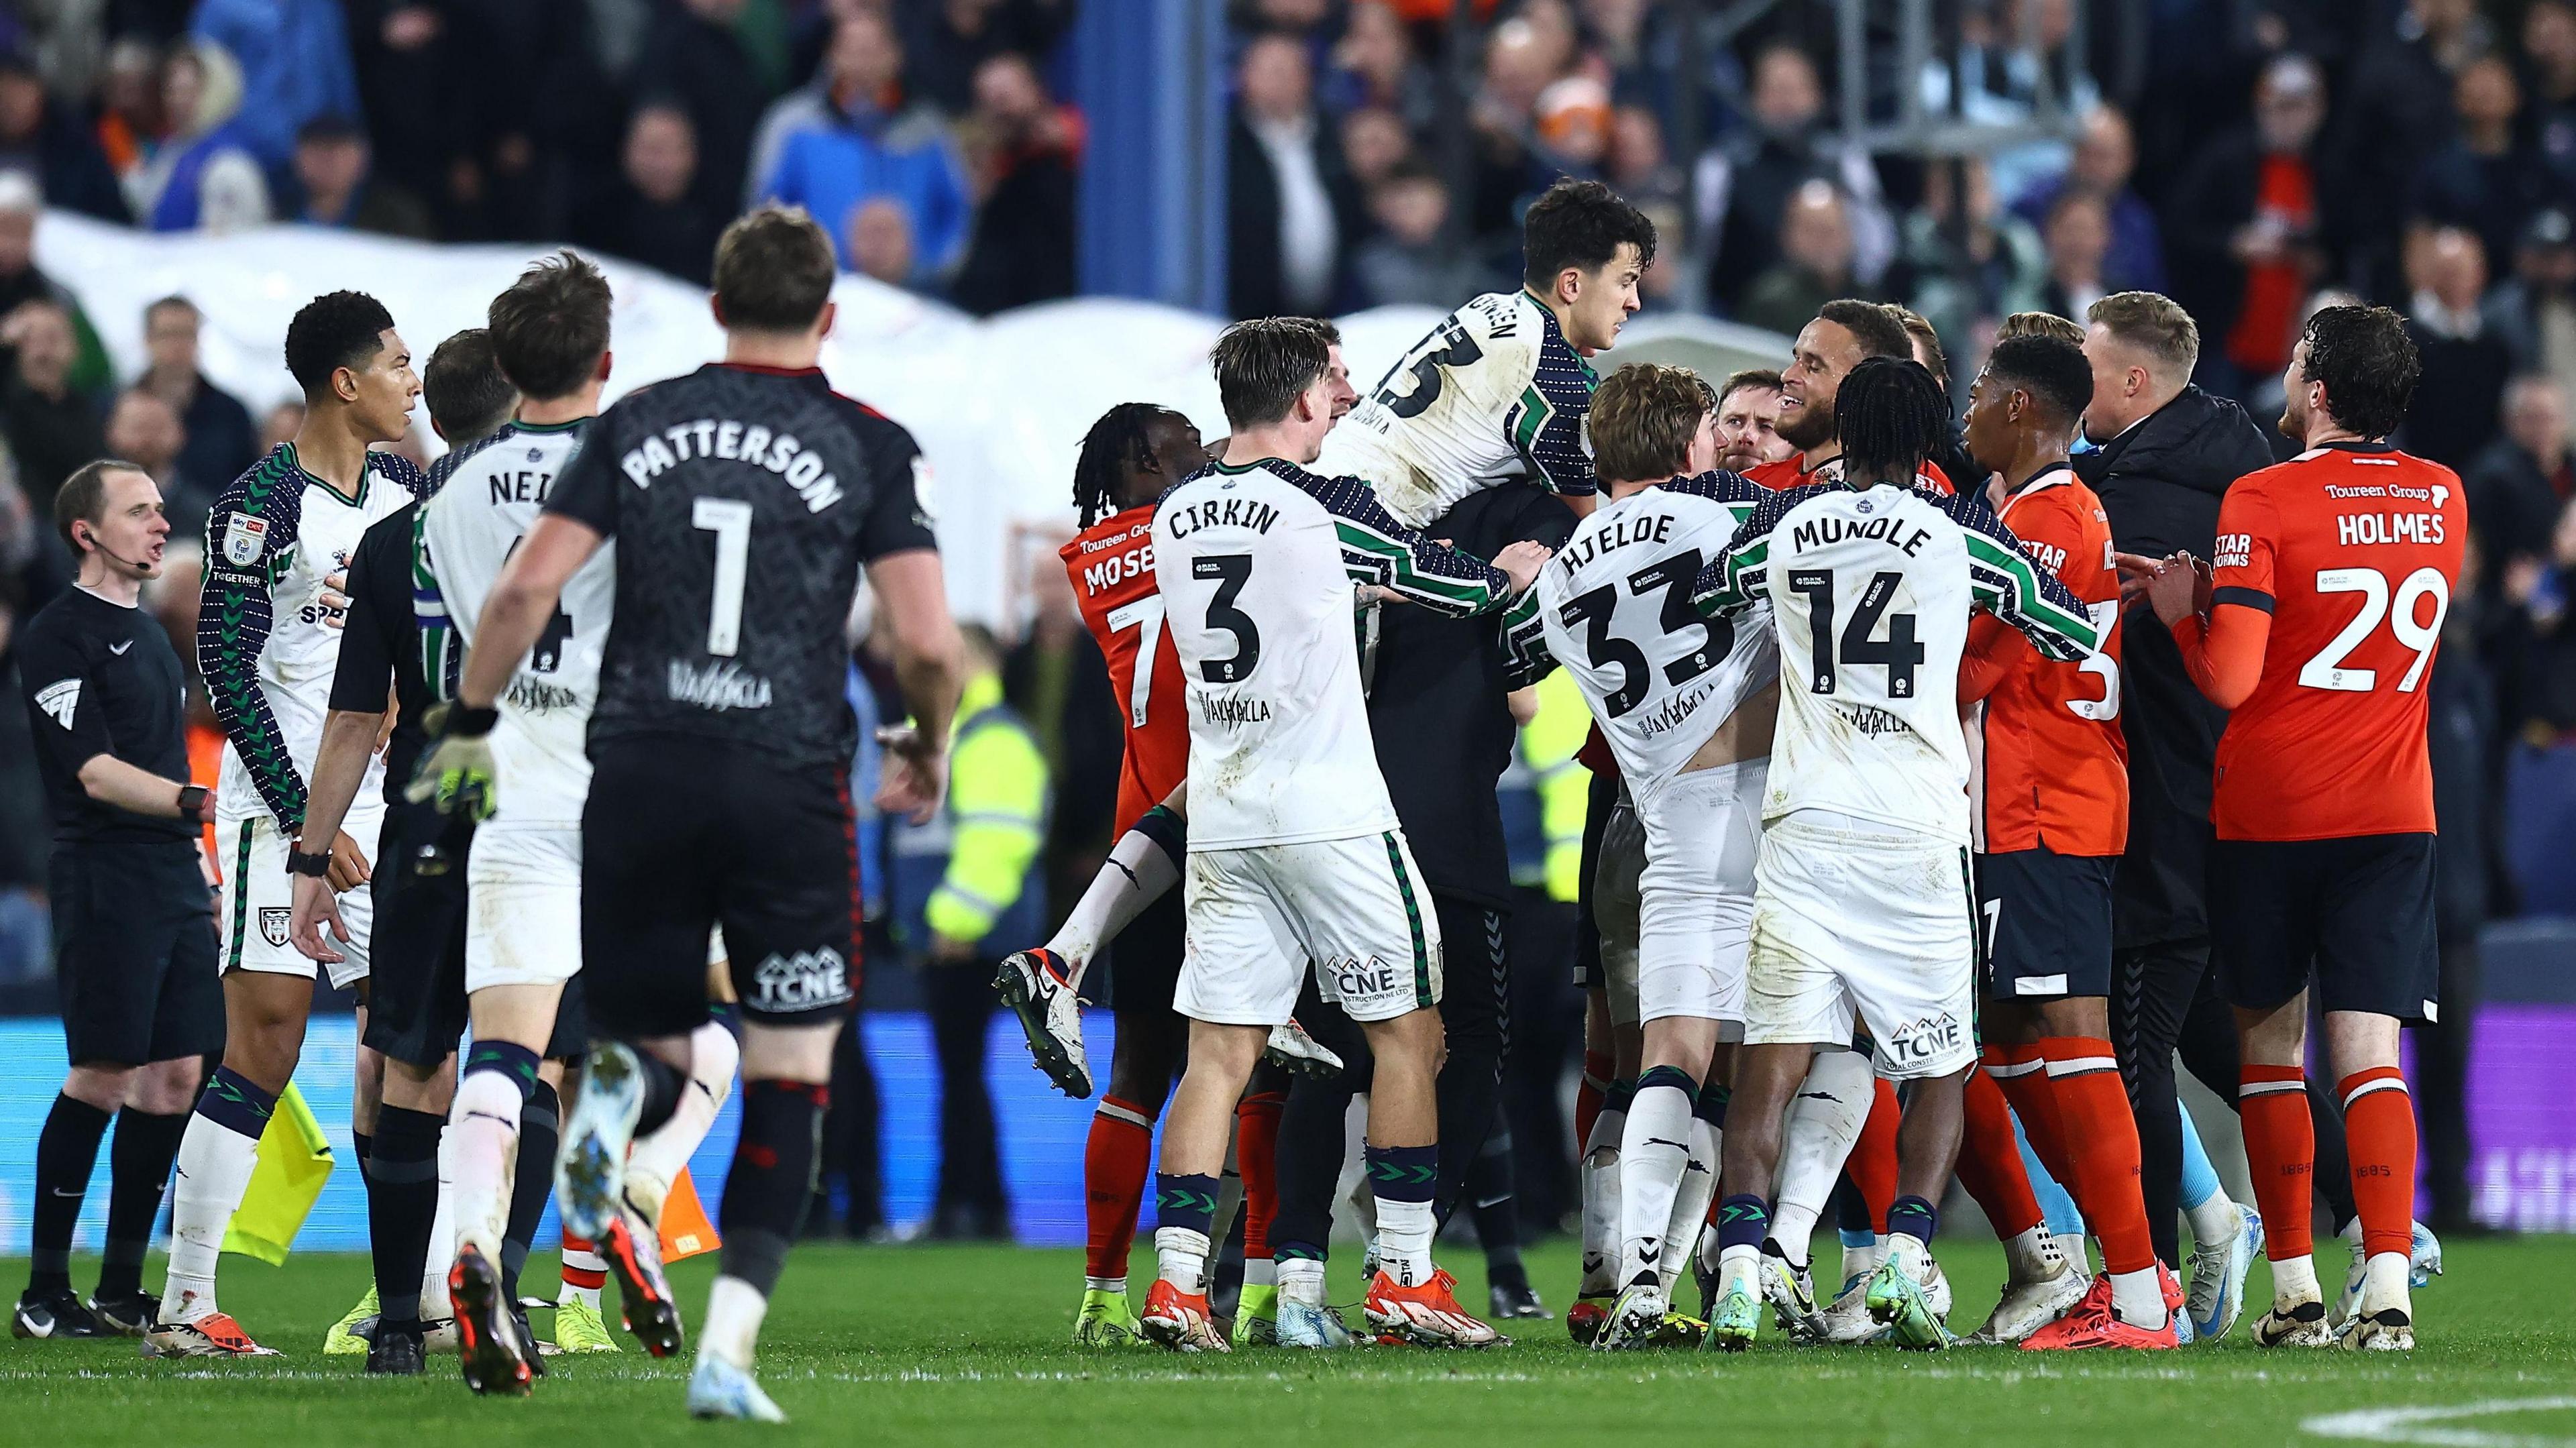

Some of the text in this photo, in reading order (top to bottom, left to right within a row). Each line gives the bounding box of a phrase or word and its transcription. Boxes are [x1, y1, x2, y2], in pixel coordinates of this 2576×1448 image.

[621, 419, 845, 514] PATTERSON
[2324, 484, 2430, 502] Toureen Group
[233, 517, 263, 532] sky bet
[1169, 499, 1279, 539] CIRKIN
[1794, 518, 1932, 559] MUNDLE
[2337, 512, 2445, 545] HOLMES
[234, 553, 246, 561] EFL
[1080, 533, 1127, 555] Toureen
[1561, 514, 1674, 576] HJELDE
[2215, 533, 2251, 555] STAR
[692, 496, 753, 657] 1
[1084, 544, 1155, 596] MOSE
[1192, 554, 1260, 683] 3
[1558, 547, 1735, 720] 33
[1788, 569, 1925, 698] 14
[2298, 567, 2449, 693] 29
[1107, 594, 1165, 729] 7
[1395, 988, 1409, 996] LTD
[1891, 1024, 1961, 1061] TCNE
